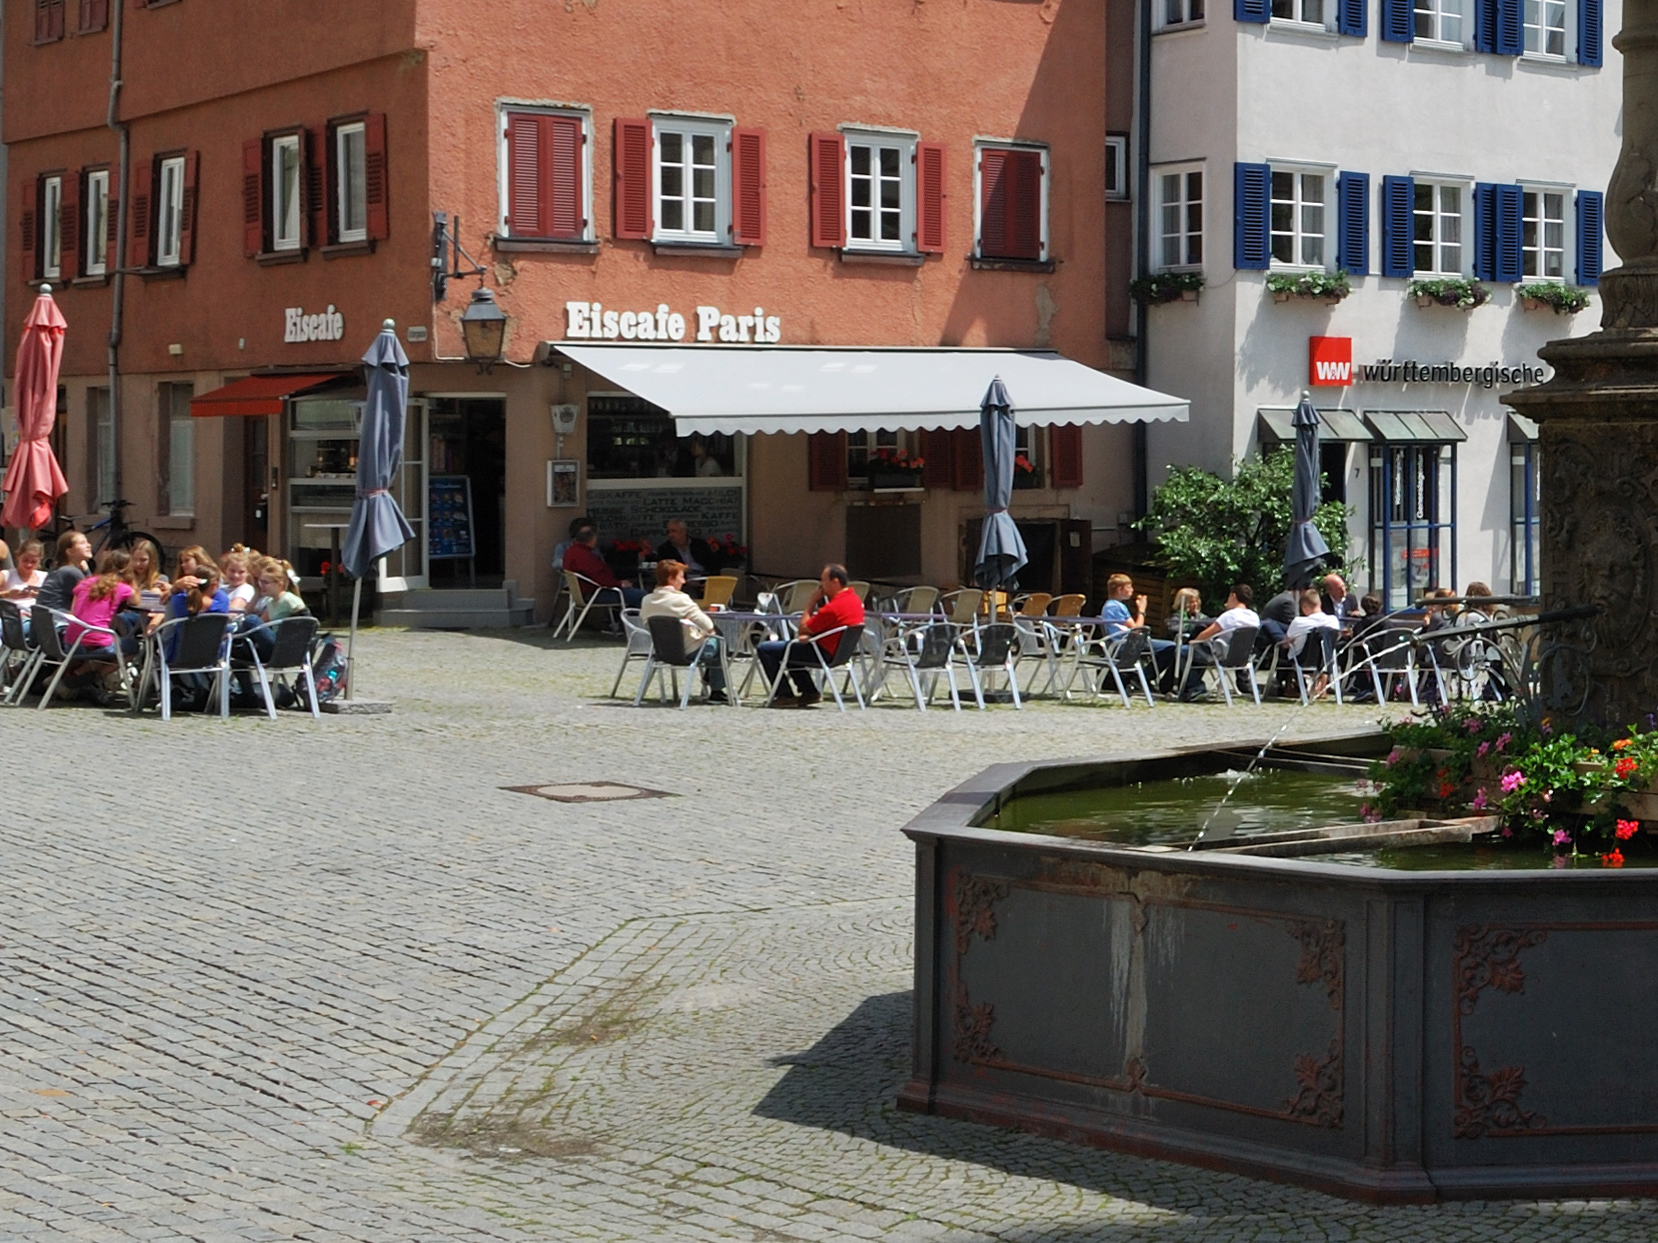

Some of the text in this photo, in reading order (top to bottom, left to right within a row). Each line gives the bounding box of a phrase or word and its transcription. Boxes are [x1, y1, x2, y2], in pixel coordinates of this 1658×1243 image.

[284, 304, 344, 342] Eiscafe
[566, 301, 781, 342] Eiscafe Paris
[1363, 359, 1545, 389] württembergische
[1354, 467, 1361, 479] 7
